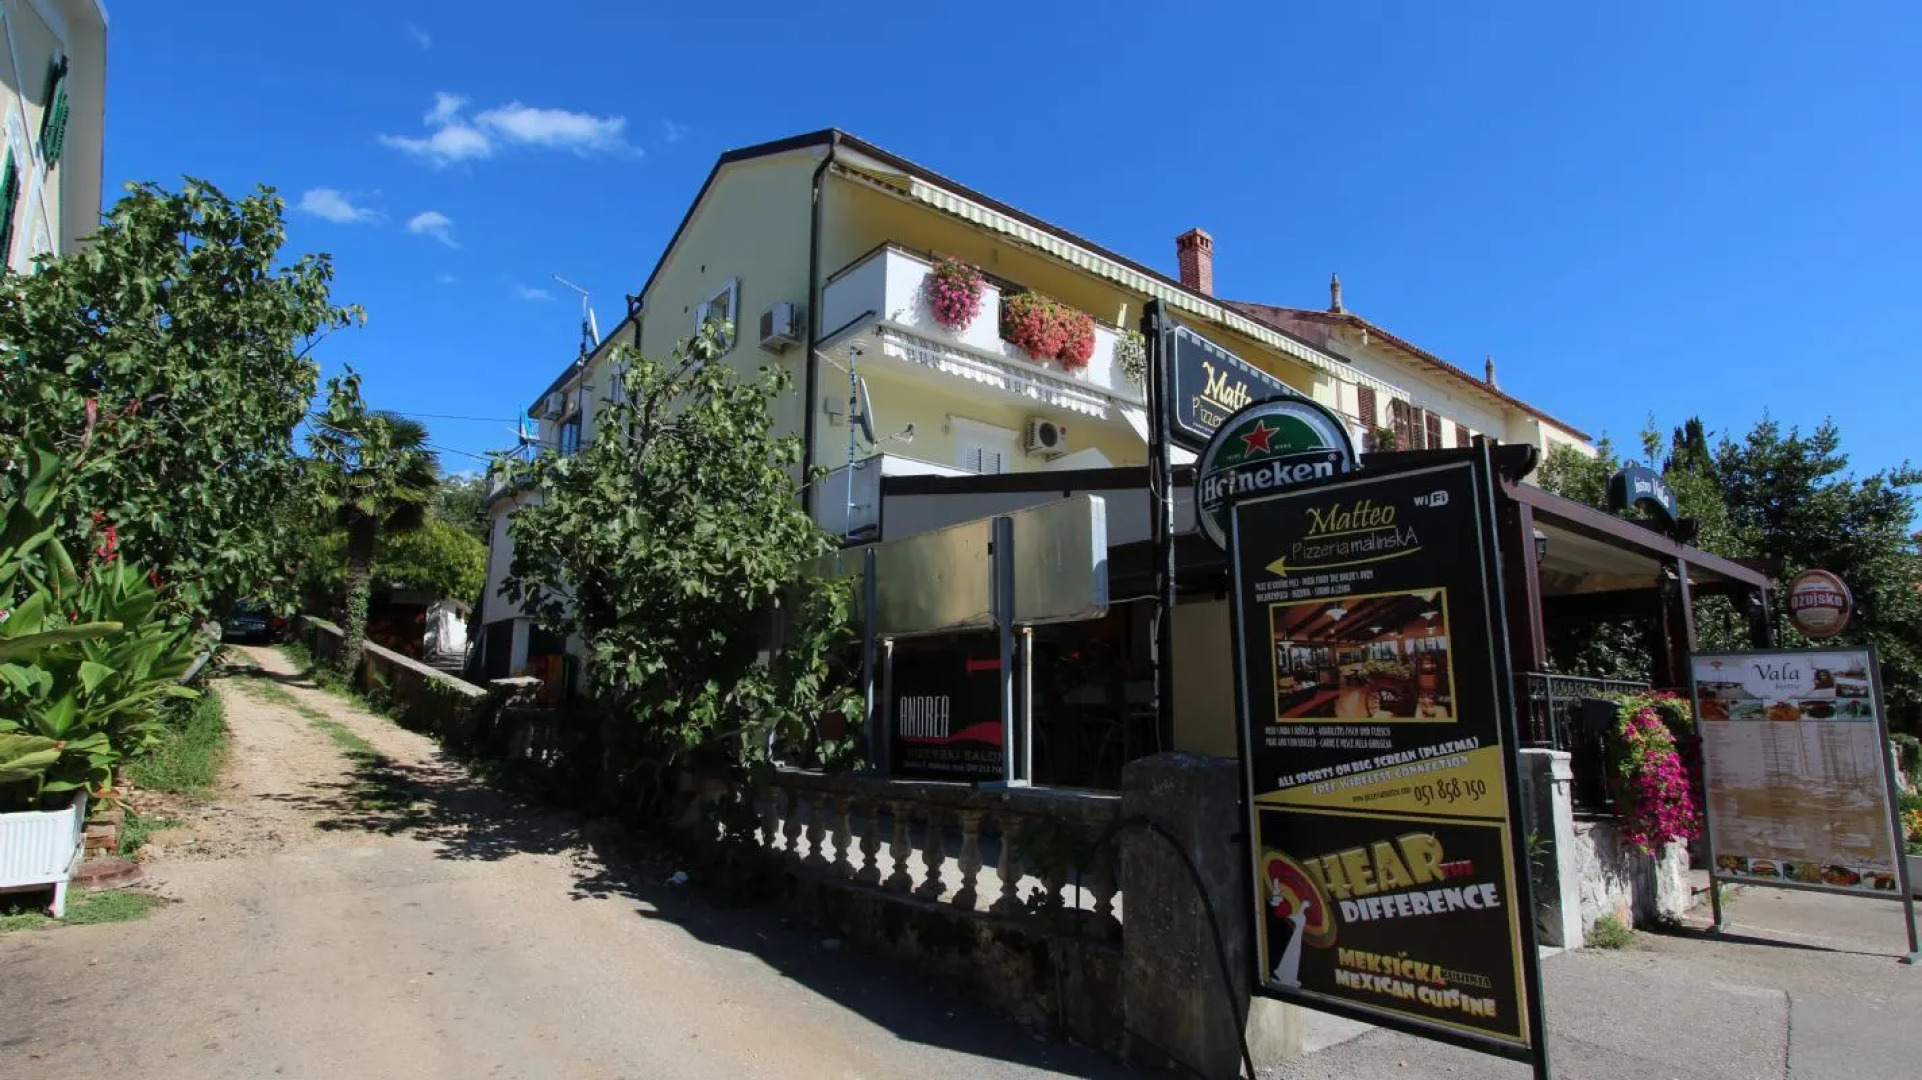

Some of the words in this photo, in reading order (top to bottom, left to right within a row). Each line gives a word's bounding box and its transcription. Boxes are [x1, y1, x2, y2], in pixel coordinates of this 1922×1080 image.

[1204, 461, 1333, 502] Heineken
[1306, 500, 1396, 535] Matteo
[1752, 662, 1800, 681] Vala
[901, 694, 949, 738] ANDREA
[1278, 777, 1295, 788] ALL
[1296, 768, 1334, 784] SPORTS
[1336, 764, 1351, 776] ON
[1352, 758, 1372, 771] BIG
[1394, 755, 1470, 777] CONNECTION
[1414, 784, 1434, 807] 051
[1438, 777, 1462, 804] 858
[1464, 777, 1487, 802] 150
[1340, 883, 1500, 923] DIFFERENCE
[1334, 969, 1415, 1000] MEXICAN
[1418, 984, 1497, 1018] CUISINE
